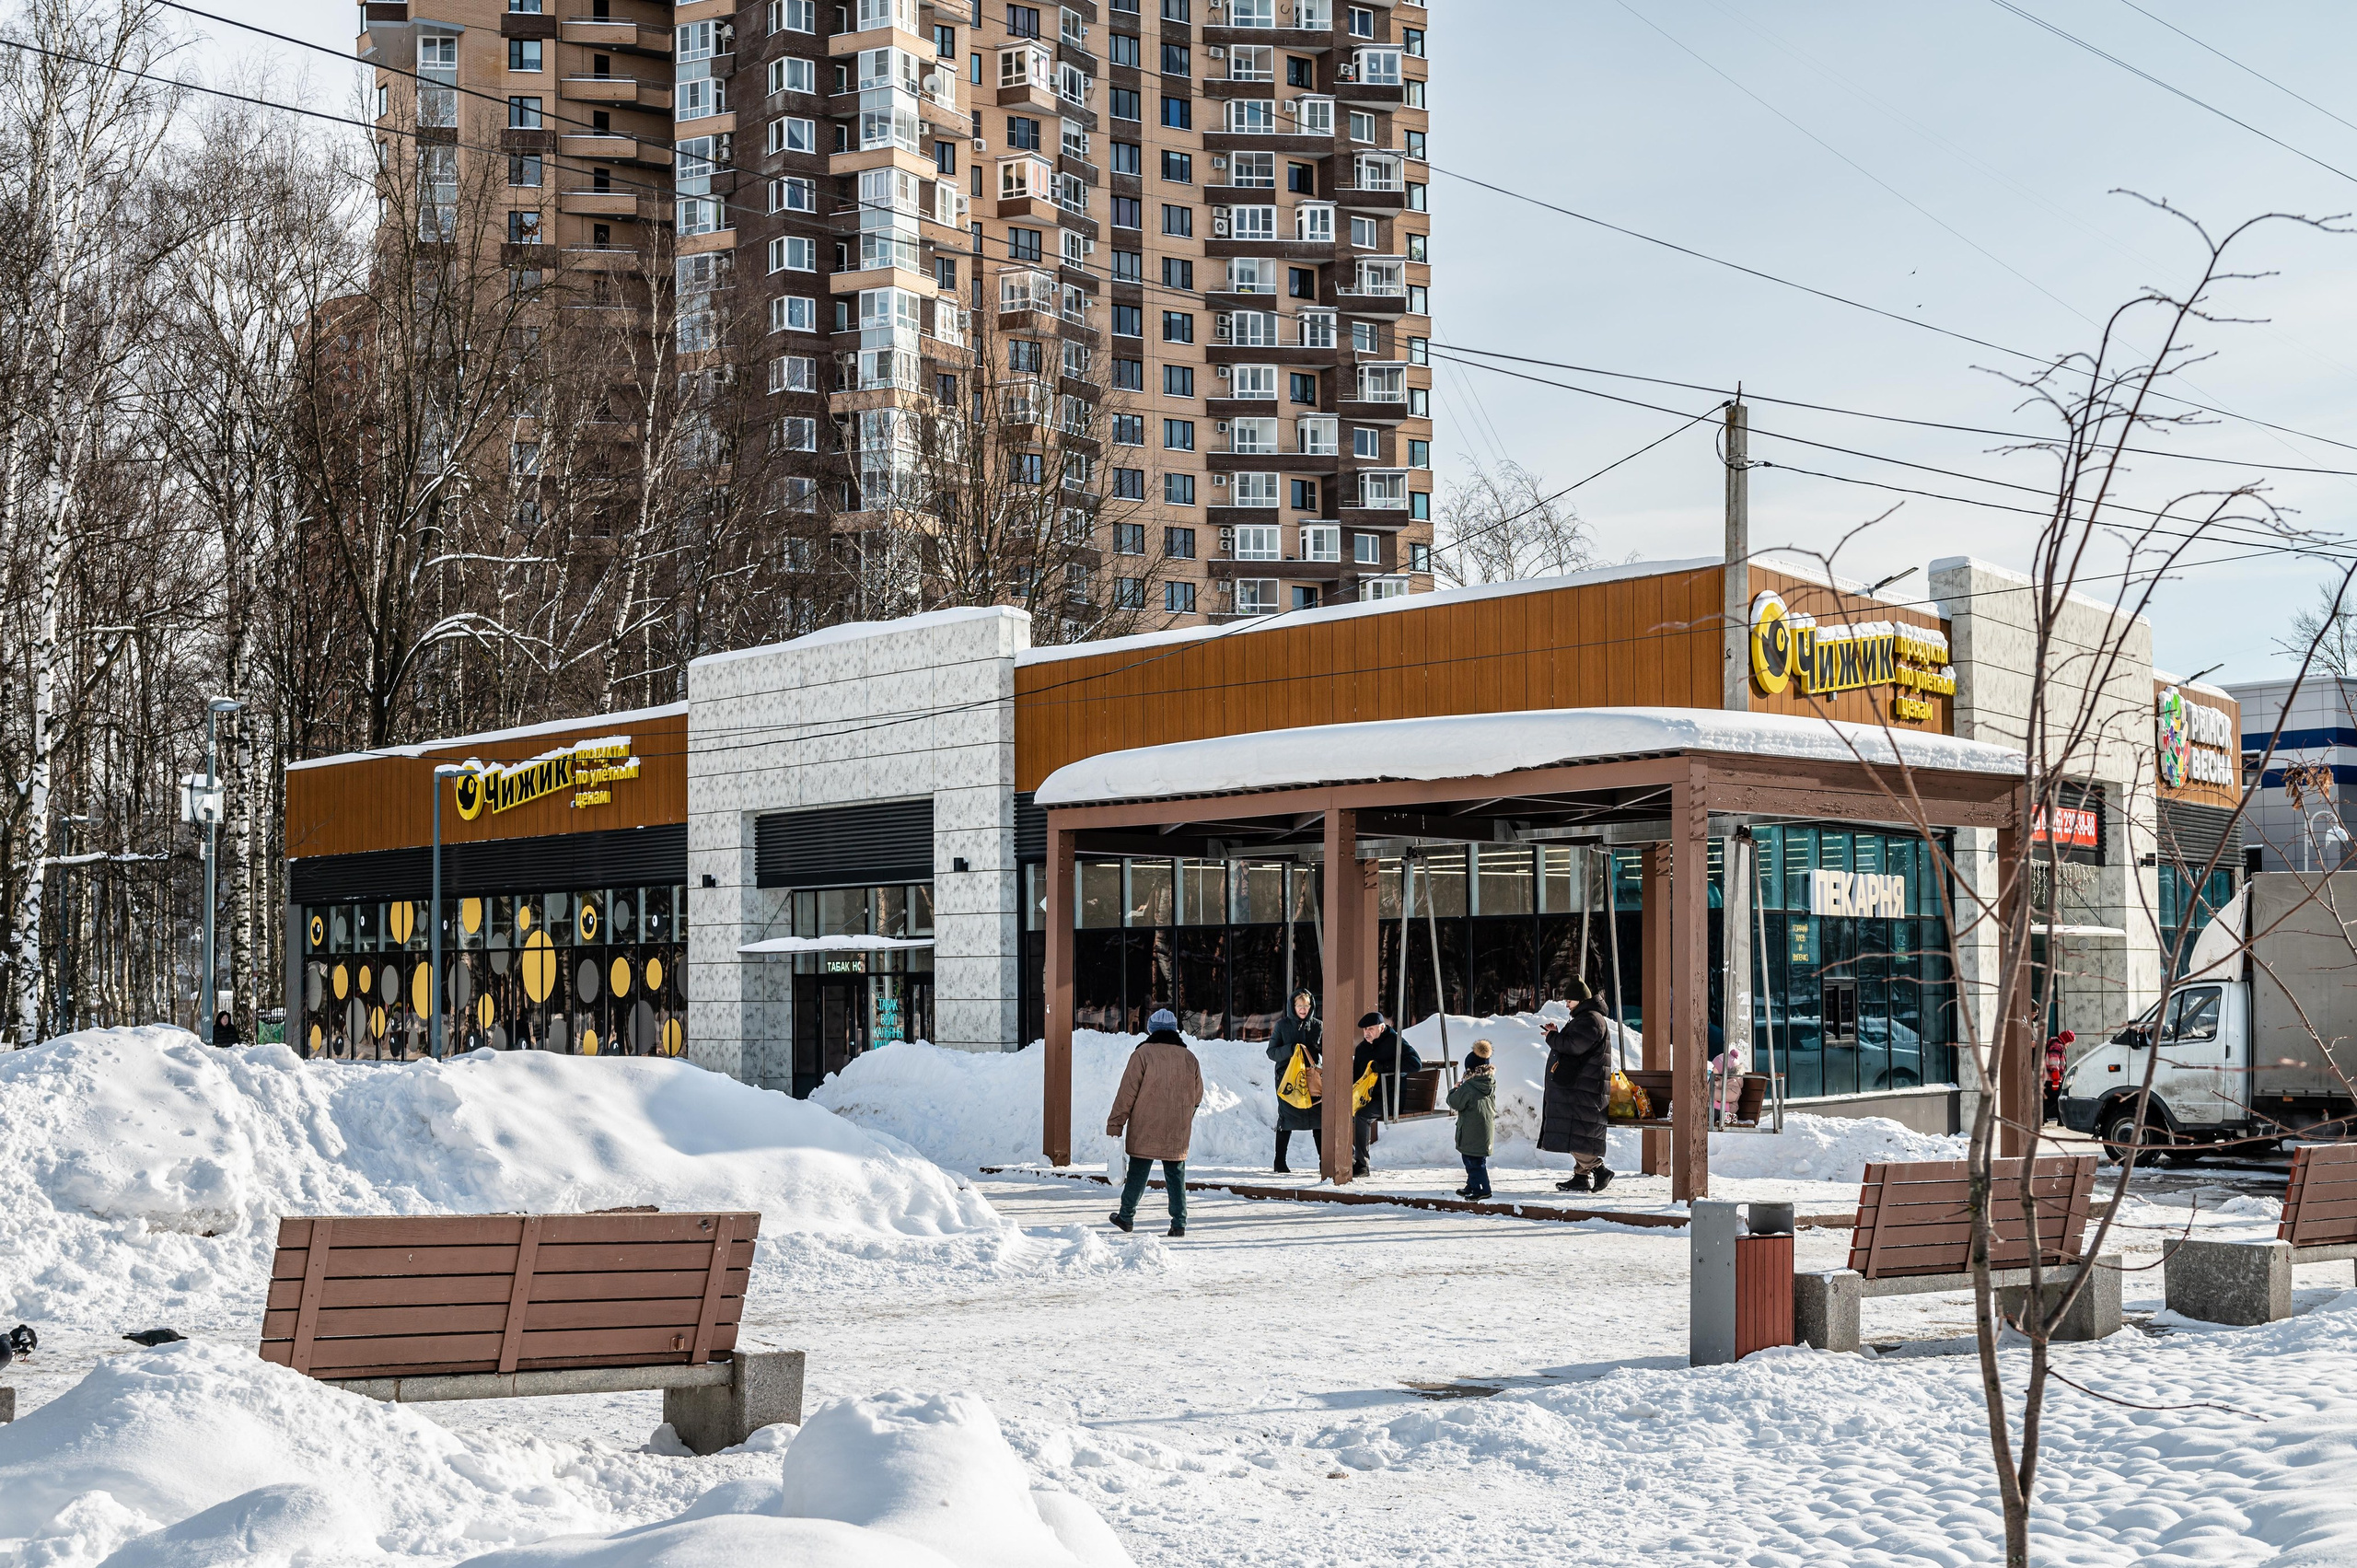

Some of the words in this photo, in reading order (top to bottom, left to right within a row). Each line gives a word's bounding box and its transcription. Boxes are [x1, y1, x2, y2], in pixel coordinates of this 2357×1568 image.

[1895, 635, 1948, 664] продукты
[1897, 668, 1914, 686] по
[1897, 697, 1933, 720] ценам
[2186, 704, 2233, 749] РЫНОК
[575, 745, 630, 766] продукты
[575, 770, 590, 784] по
[590, 763, 639, 787] улётным
[2189, 749, 2234, 785] ВЕСНА
[575, 792, 611, 808] ценам
[1810, 869, 1905, 918] ПЕКАРНЯ
[827, 961, 850, 972] ТАБАК
[877, 998, 899, 1011] ТАБАК
[880, 1012, 898, 1026] ВЕЙП
[873, 1027, 904, 1039] КАЛЬЯНЫ
